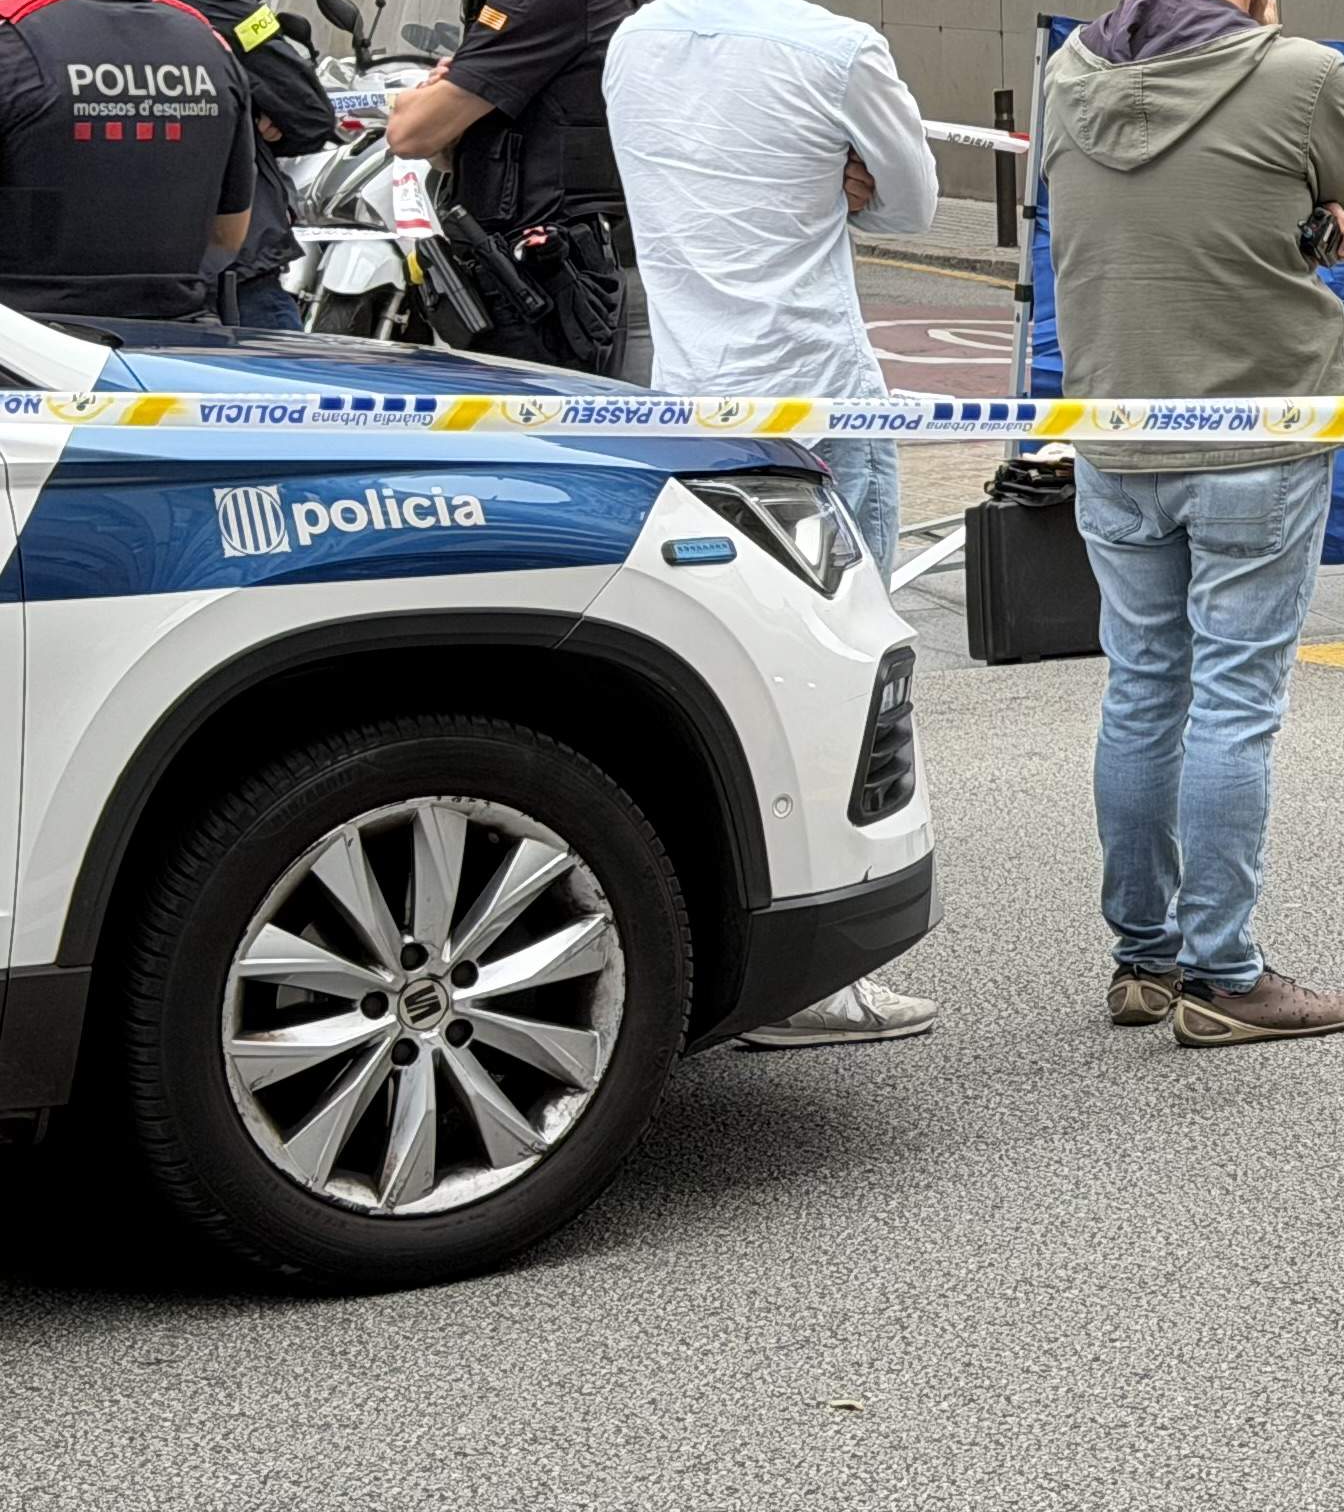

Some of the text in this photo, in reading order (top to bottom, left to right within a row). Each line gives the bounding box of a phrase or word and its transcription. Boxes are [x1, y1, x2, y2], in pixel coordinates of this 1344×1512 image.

[67, 64, 217, 96] POLICIA
[74, 99, 219, 119] mossos d'esquadra
[5, 397, 42, 414] NO
[200, 403, 307, 425] POLICIA
[311, 411, 367, 425] Urbana
[561, 406, 693, 425] NO PASSEU
[829, 413, 924, 431] POLICIA
[1142, 414, 1261, 431] NO PASSEU
[926, 420, 976, 433] Urbana
[292, 487, 486, 546] policia
